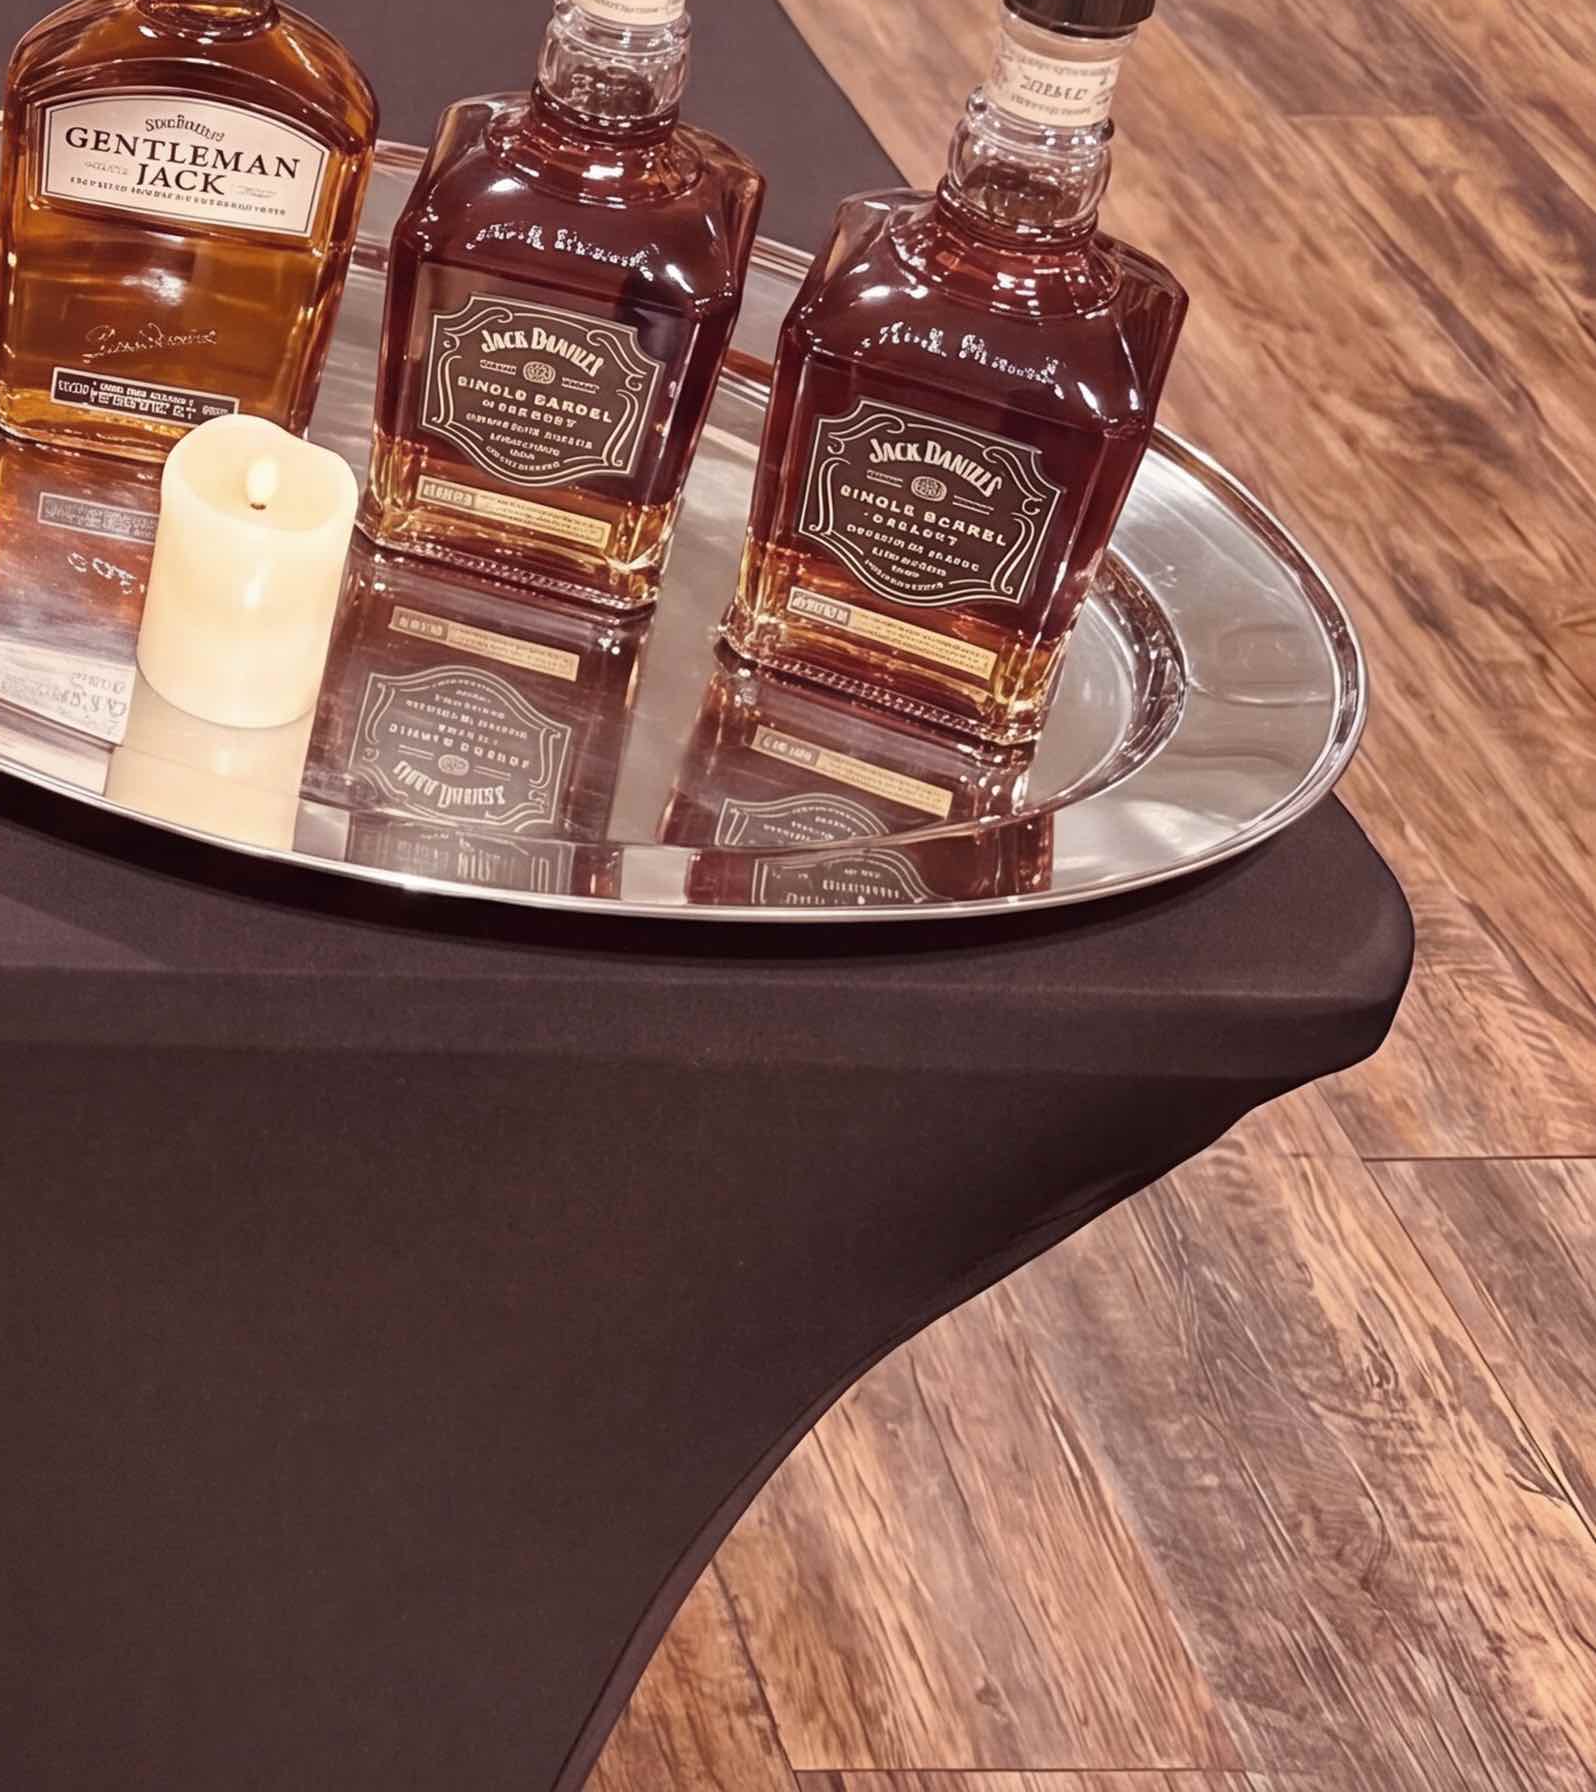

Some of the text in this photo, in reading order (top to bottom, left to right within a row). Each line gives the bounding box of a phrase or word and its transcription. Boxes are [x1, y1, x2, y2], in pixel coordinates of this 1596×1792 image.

[65, 126, 300, 179] GENTLEMAN
[136, 163, 227, 195] JACK
[868, 438, 923, 464] JACK
